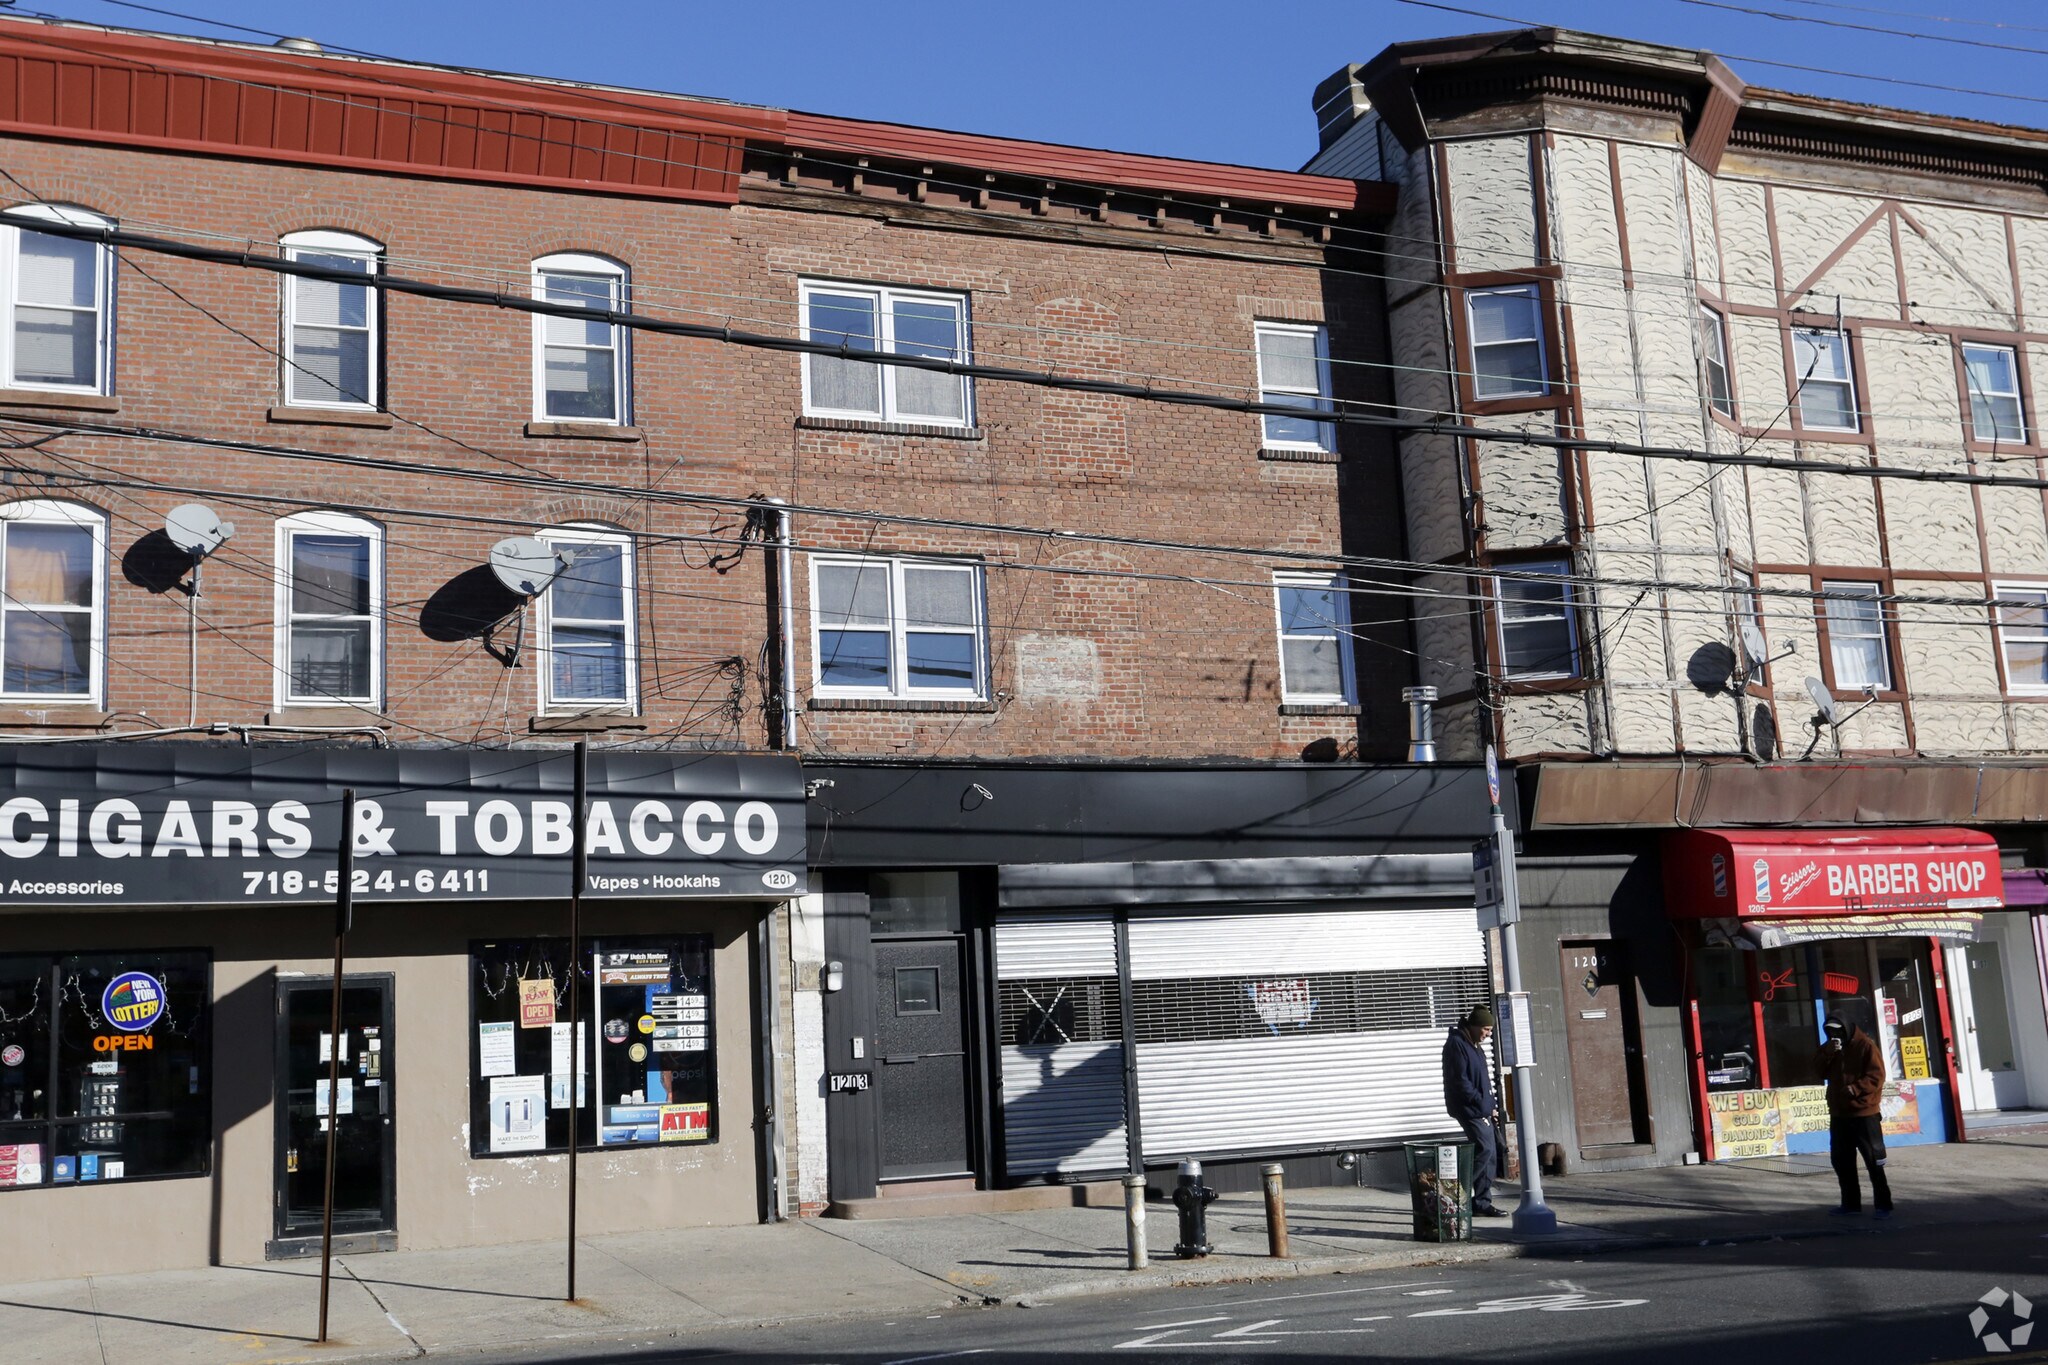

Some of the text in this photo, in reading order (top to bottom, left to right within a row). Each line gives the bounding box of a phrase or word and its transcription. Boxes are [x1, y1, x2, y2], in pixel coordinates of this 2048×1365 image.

[0, 797, 780, 858] CIGARS & TOBACCO
[243, 870, 488, 894] 718-524-6411
[589, 874, 721, 890] Vapes Hookahs
[768, 874, 791, 885] 1201
[1779, 860, 1817, 893] Scissors
[1827, 861, 1986, 896] BARBER SHOP
[8, 879, 124, 895] Accessories
[1748, 904, 1766, 913] 1205
[1841, 896, 1868, 912] TEL
[1574, 956, 1606, 967] 1205
[131, 980, 151, 990] NEW
[133, 988, 157, 1002] YORK
[525, 989, 549, 1002] RAW
[111, 1000, 159, 1022] LOTTERY
[526, 1006, 549, 1018] OPEN
[1904, 1011, 1921, 1024] 1205
[93, 1034, 153, 1052] OPEN
[1905, 1045, 1922, 1055] GOLD
[1910, 1068, 1924, 1077] ORO
[833, 1075, 867, 1090] 1203
[1712, 1090, 1776, 1112] WE BUY
[1788, 1089, 1827, 1103] PLATIN
[661, 1111, 709, 1131] ATM
[1733, 1113, 1760, 1126] GOLD
[1721, 1128, 1775, 1143] DIAMONDS
[1732, 1143, 1767, 1156] SILVER
